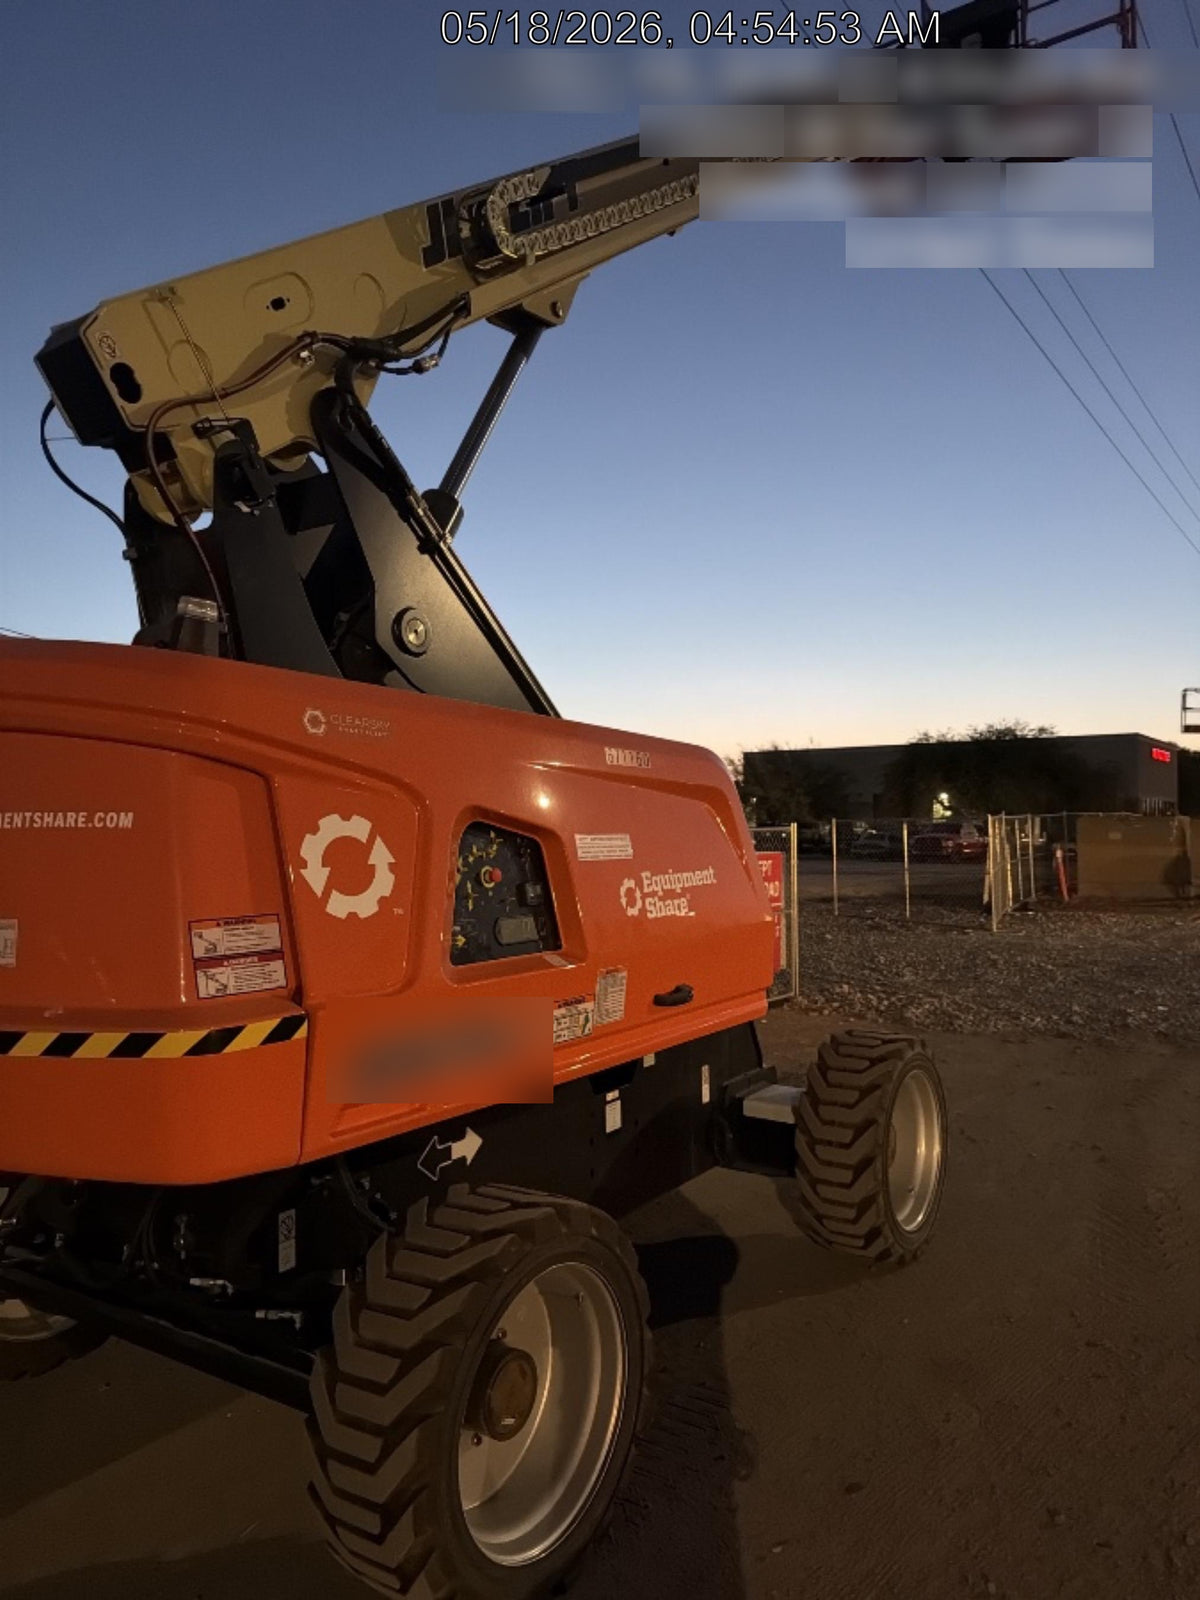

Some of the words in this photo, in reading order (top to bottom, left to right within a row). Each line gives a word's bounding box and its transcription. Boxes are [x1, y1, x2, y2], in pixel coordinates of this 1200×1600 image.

[0, 811, 134, 829] ENTSHARE.COM
[641, 865, 717, 896] Equipment
[645, 896, 690, 919] Share
